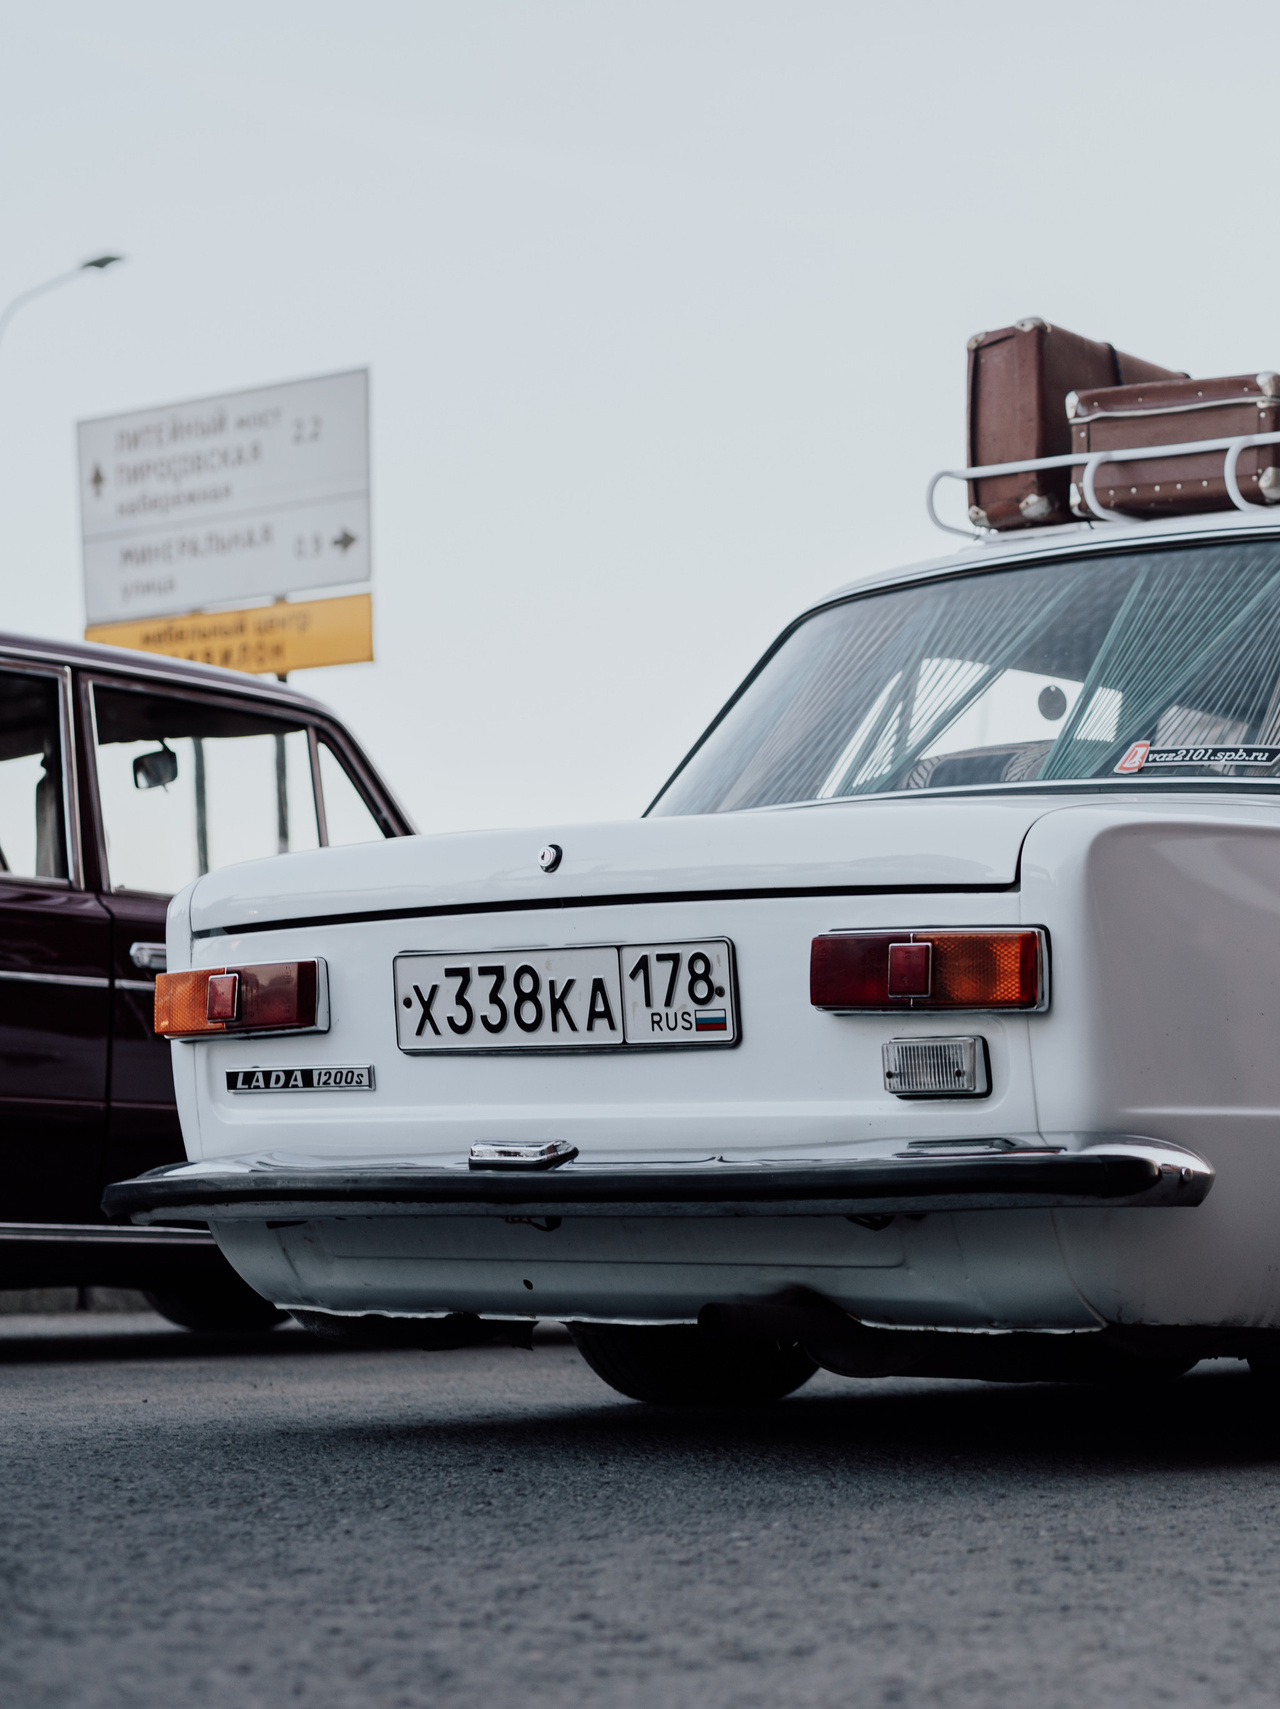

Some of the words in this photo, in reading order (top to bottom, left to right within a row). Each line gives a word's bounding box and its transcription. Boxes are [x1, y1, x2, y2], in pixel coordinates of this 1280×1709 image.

[1148, 748, 1270, 763] vaz2101.spb.ru
[411, 963, 617, 1037] Х338КА
[628, 951, 716, 1008] 178
[650, 1011, 694, 1032] RUS
[236, 1071, 304, 1089] LADA
[316, 1070, 364, 1086] 1200s
